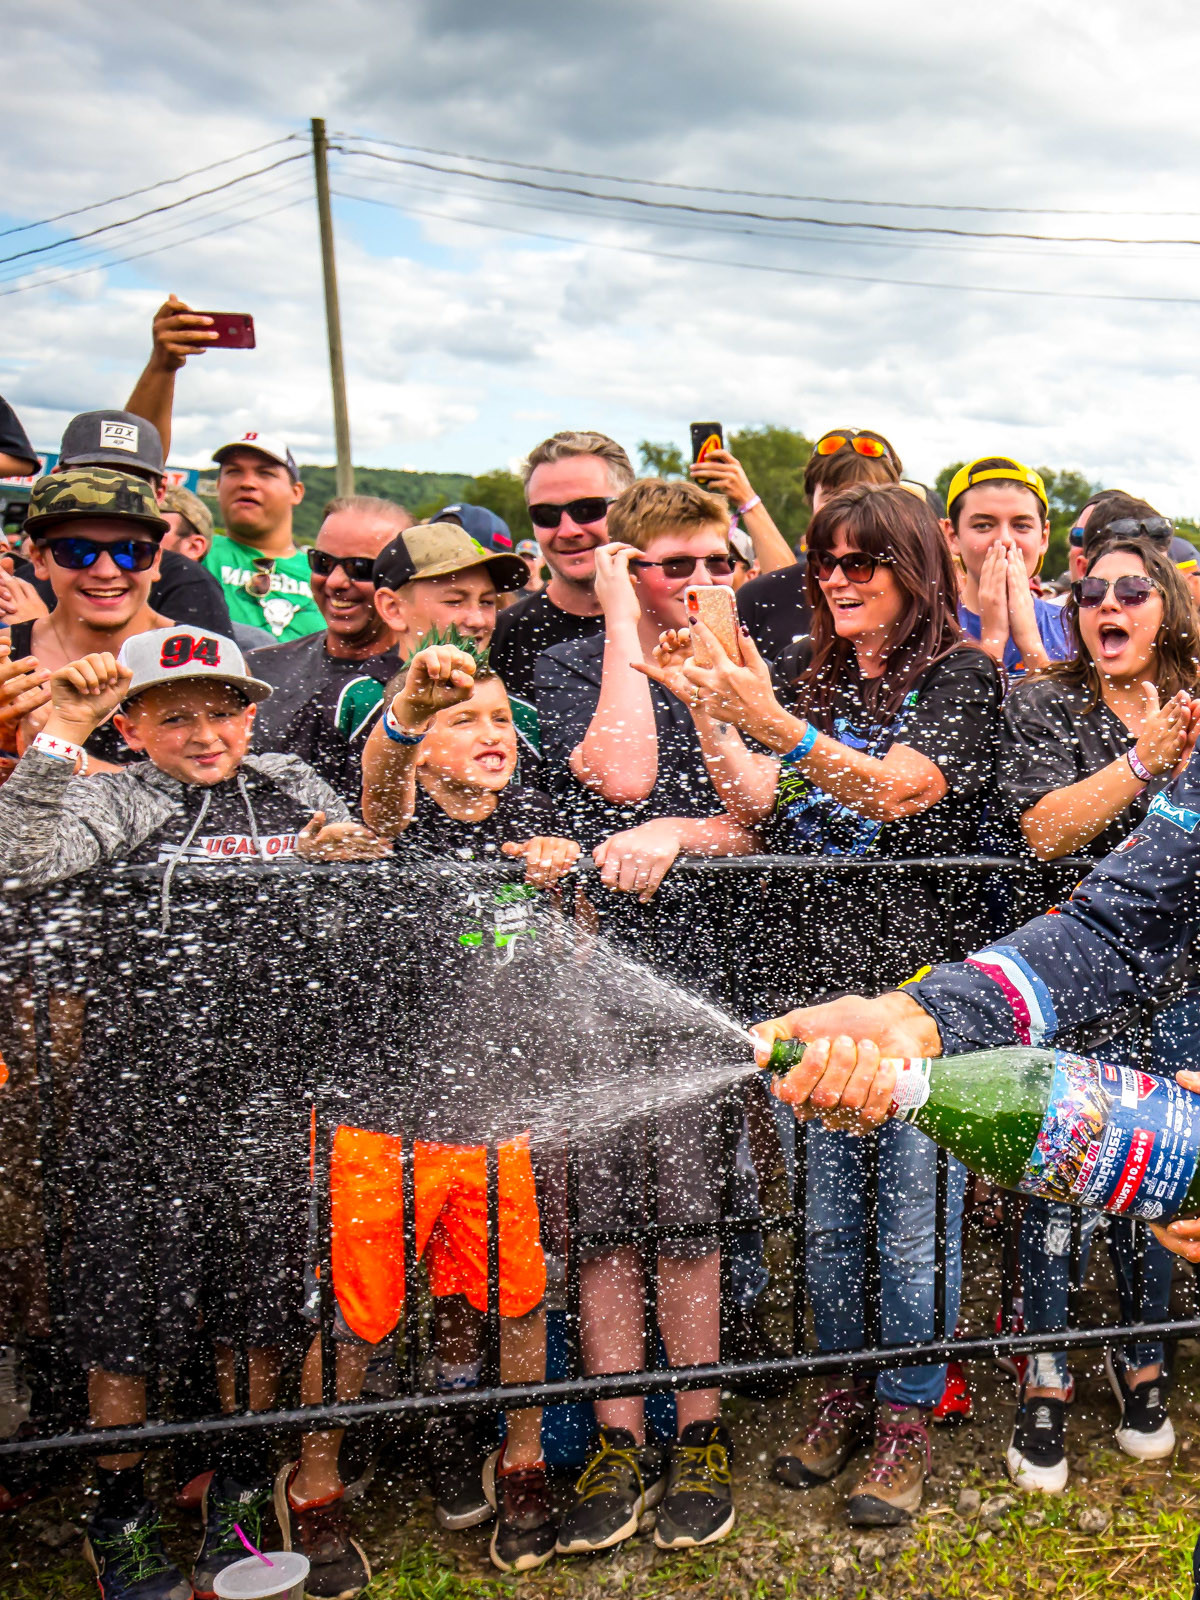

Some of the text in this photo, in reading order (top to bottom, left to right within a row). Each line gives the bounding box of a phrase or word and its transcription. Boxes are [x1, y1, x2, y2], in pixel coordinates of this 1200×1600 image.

[104, 426, 135, 438] FOX
[160, 634, 221, 669] 94
[1073, 1143, 1101, 1192] LUCAS OIL
[1082, 1125, 1123, 1206] MOTOCROSS
[1111, 1131, 1149, 1210] AUGUST 10, 2019
